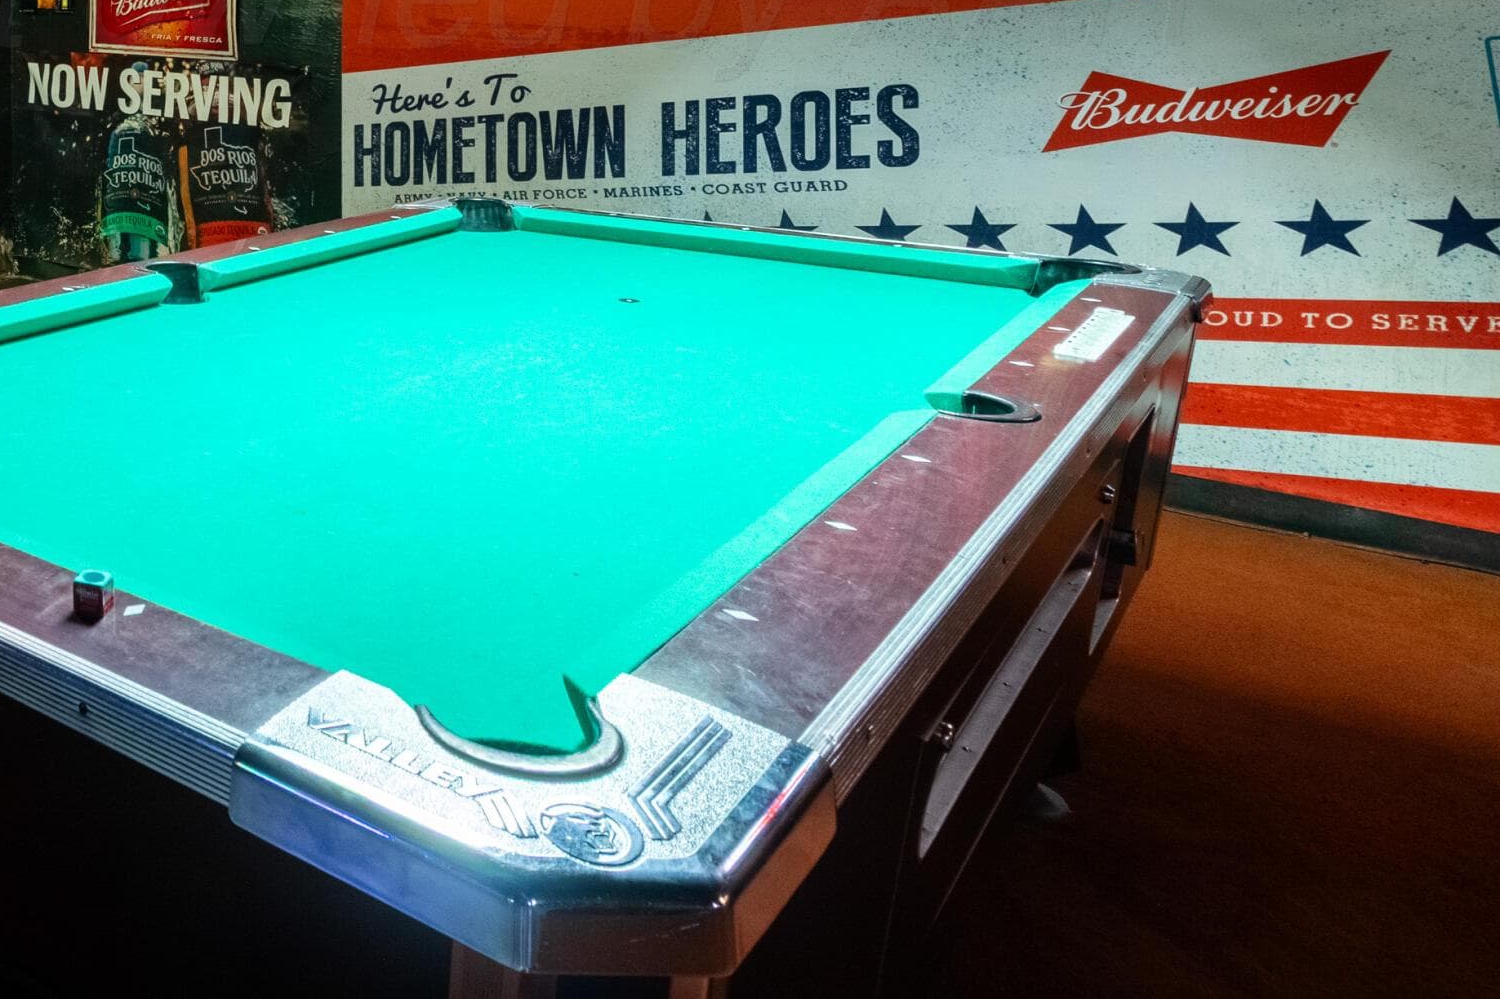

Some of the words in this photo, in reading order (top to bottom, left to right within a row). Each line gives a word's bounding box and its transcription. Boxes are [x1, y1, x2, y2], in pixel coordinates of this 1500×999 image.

[151, 33, 172, 41] FRIA
[183, 35, 223, 44] FRESCA
[27, 60, 110, 112] NOW
[117, 66, 293, 130] SERVING
[371, 76, 476, 116] Here's
[483, 73, 532, 106] To
[1059, 86, 1361, 131] Budweiser
[353, 103, 626, 188] HOMETOWN
[660, 83, 920, 177] HEROES
[112, 153, 138, 170] DOS
[137, 158, 164, 176] RIOS
[200, 147, 226, 167] DOS
[227, 149, 257, 170] RIOS
[112, 169, 167, 191] TEQUILA
[200, 167, 258, 190] TEQUILA
[503, 190, 529, 201] AIR
[534, 188, 588, 201] FORCE
[603, 184, 684, 199] MARINES
[702, 181, 767, 196] COAST
[773, 178, 849, 194] GUARD
[1203, 310, 1283, 328] OUD
[1300, 312, 1354, 330] TO
[1372, 314, 1500, 334] SERVE
[306, 704, 506, 803] VALLEY
